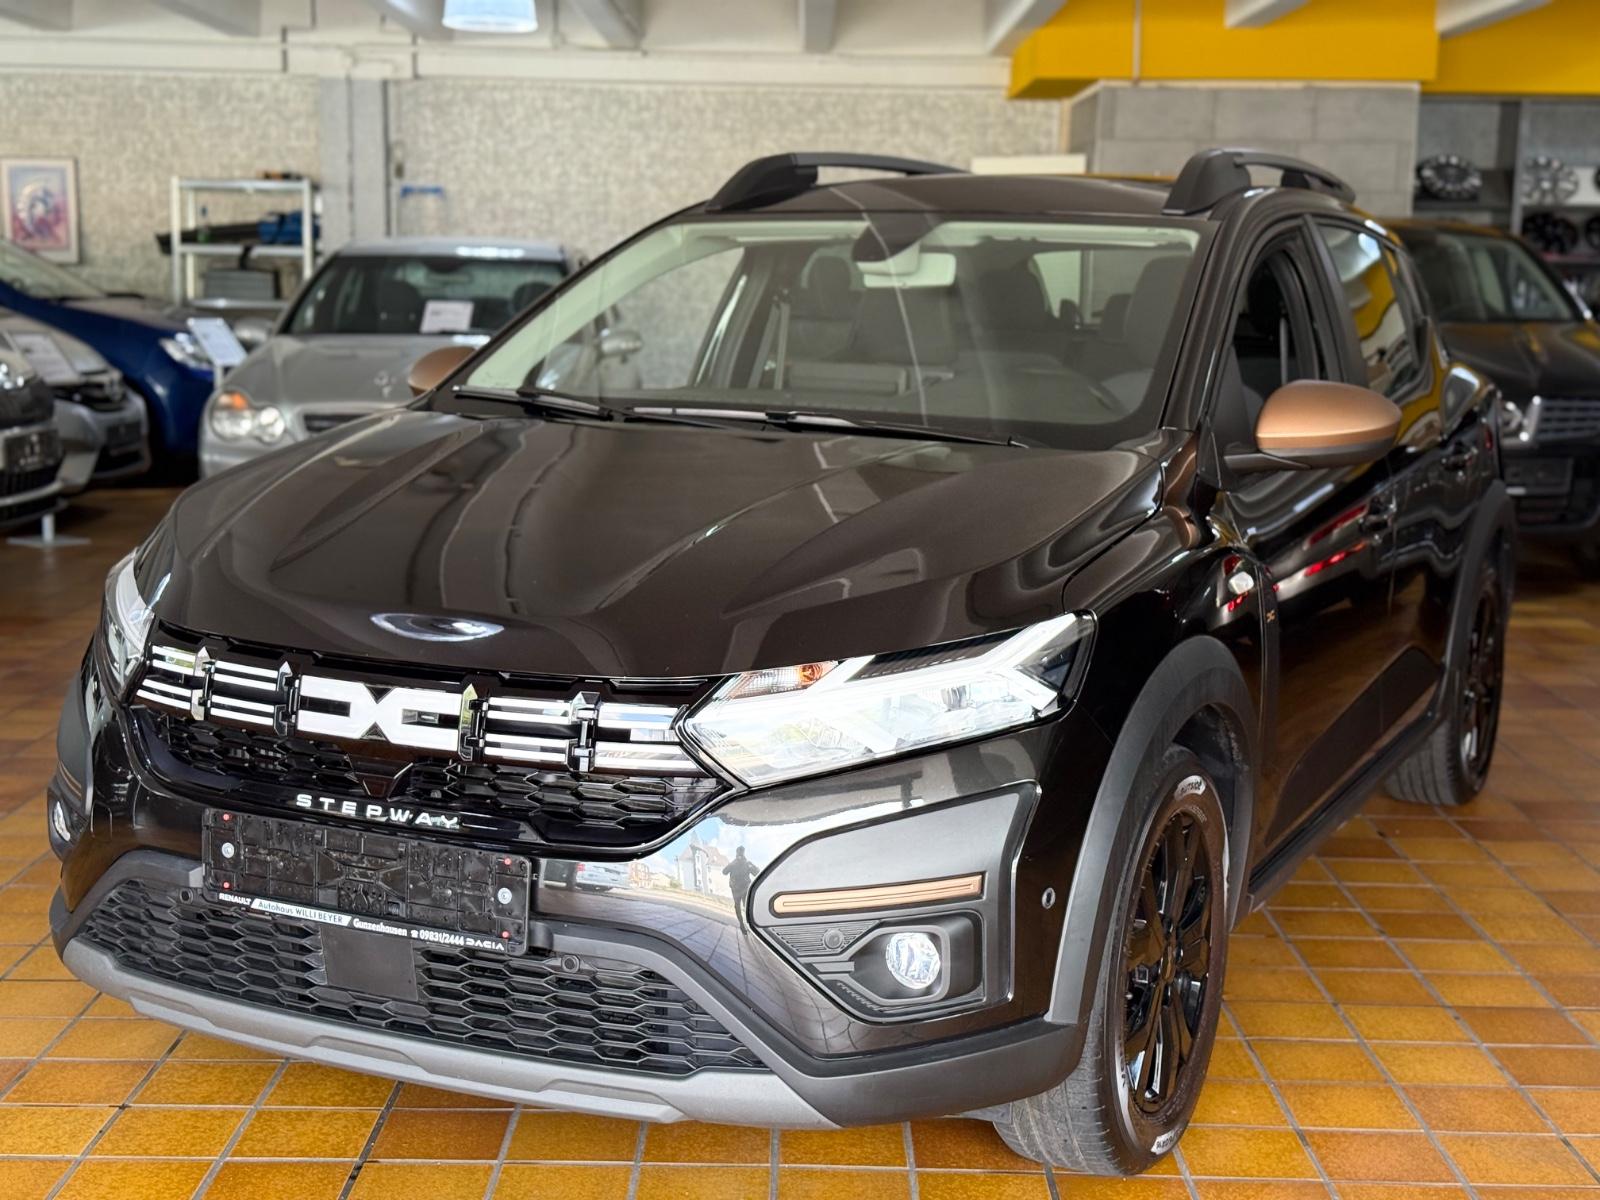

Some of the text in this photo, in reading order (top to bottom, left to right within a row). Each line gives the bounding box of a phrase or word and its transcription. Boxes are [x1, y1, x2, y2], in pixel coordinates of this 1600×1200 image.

[296, 793, 459, 829] STEPWAY
[219, 892, 505, 951] RENAULT Autohaus WILLI BEYER Gunzenhausen 09831/2444 DACIA
